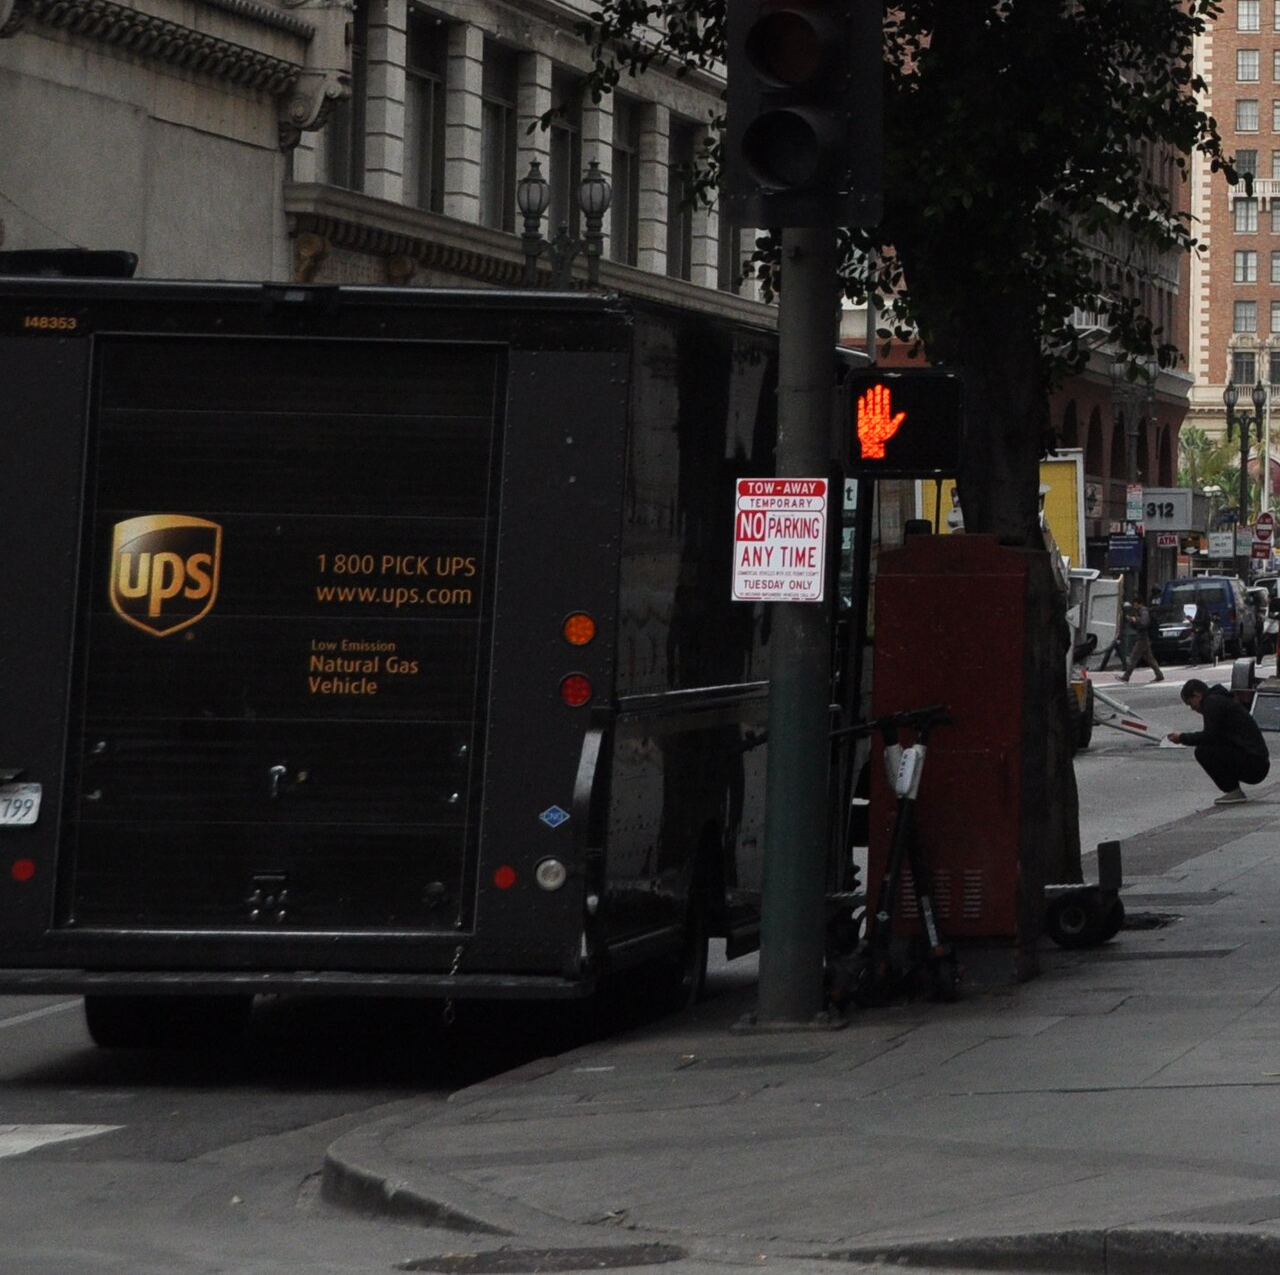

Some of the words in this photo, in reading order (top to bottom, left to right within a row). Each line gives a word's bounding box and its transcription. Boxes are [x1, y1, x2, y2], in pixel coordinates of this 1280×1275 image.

[24, 316, 77, 331] 148353
[748, 482, 817, 495] TOW-AWAY
[750, 498, 813, 508] TEMPORARY
[1146, 501, 1175, 519] 312
[740, 512, 765, 540] NO
[768, 517, 820, 539] PARKING
[1159, 535, 1177, 546] ATM
[317, 553, 327, 574] 1
[333, 553, 375, 574] 800
[381, 555, 429, 575] PICK
[436, 557, 476, 577] UPS
[741, 546, 774, 567] ANY
[781, 546, 818, 568] TIME
[119, 551, 213, 618] ups
[743, 579, 786, 590] TUESDAY
[788, 579, 814, 590] ONLY
[316, 586, 472, 608] www.ups.com
[311, 639, 337, 652] Low
[341, 639, 396, 652] Emission
[309, 655, 379, 674] Natural
[385, 656, 419, 674] Gas
[308, 676, 378, 695] Vehicle
